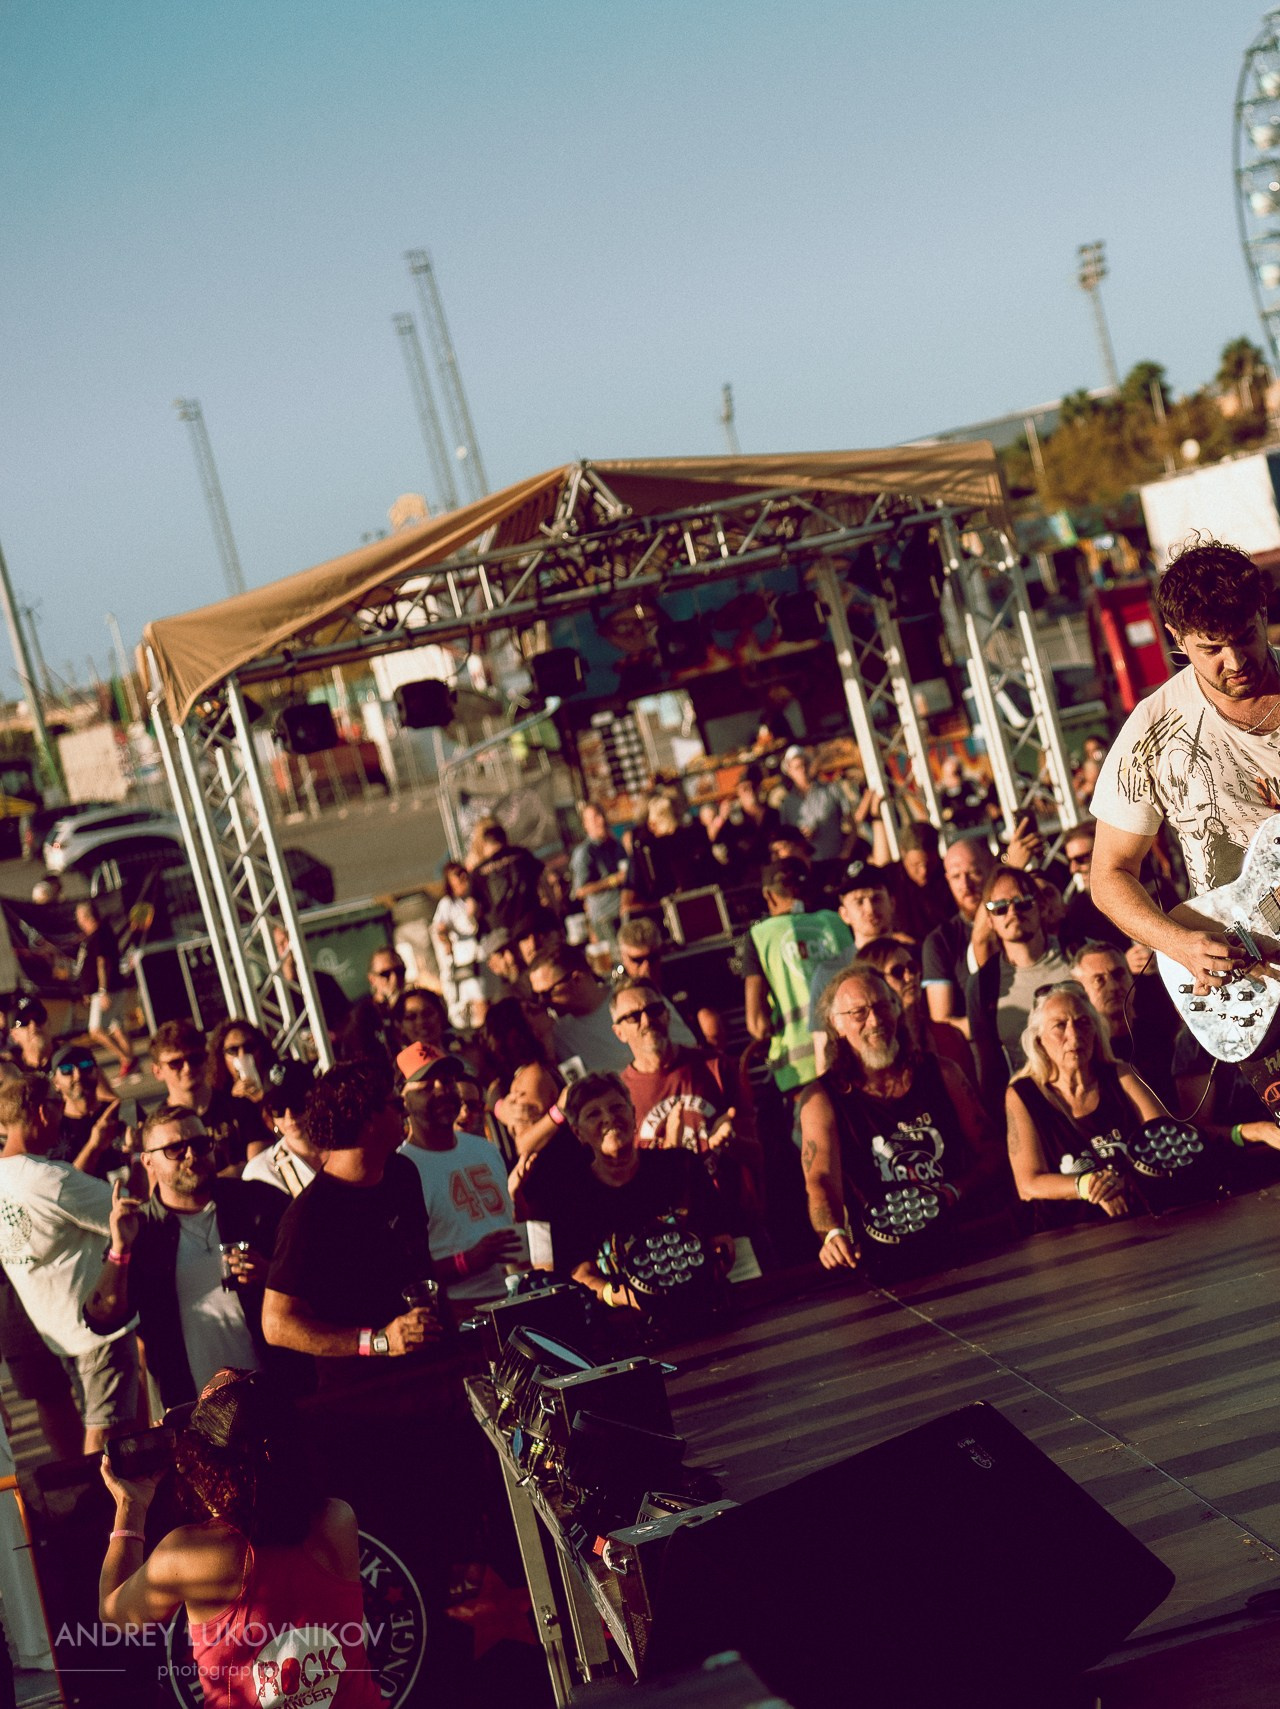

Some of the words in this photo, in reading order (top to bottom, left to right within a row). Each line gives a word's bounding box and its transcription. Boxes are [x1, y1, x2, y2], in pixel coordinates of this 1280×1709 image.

[449, 1163, 506, 1222] 45
[256, 1646, 344, 1699] ROCK
[379, 1609, 415, 1698] UNGE
[273, 1687, 334, 1709] ANCER
